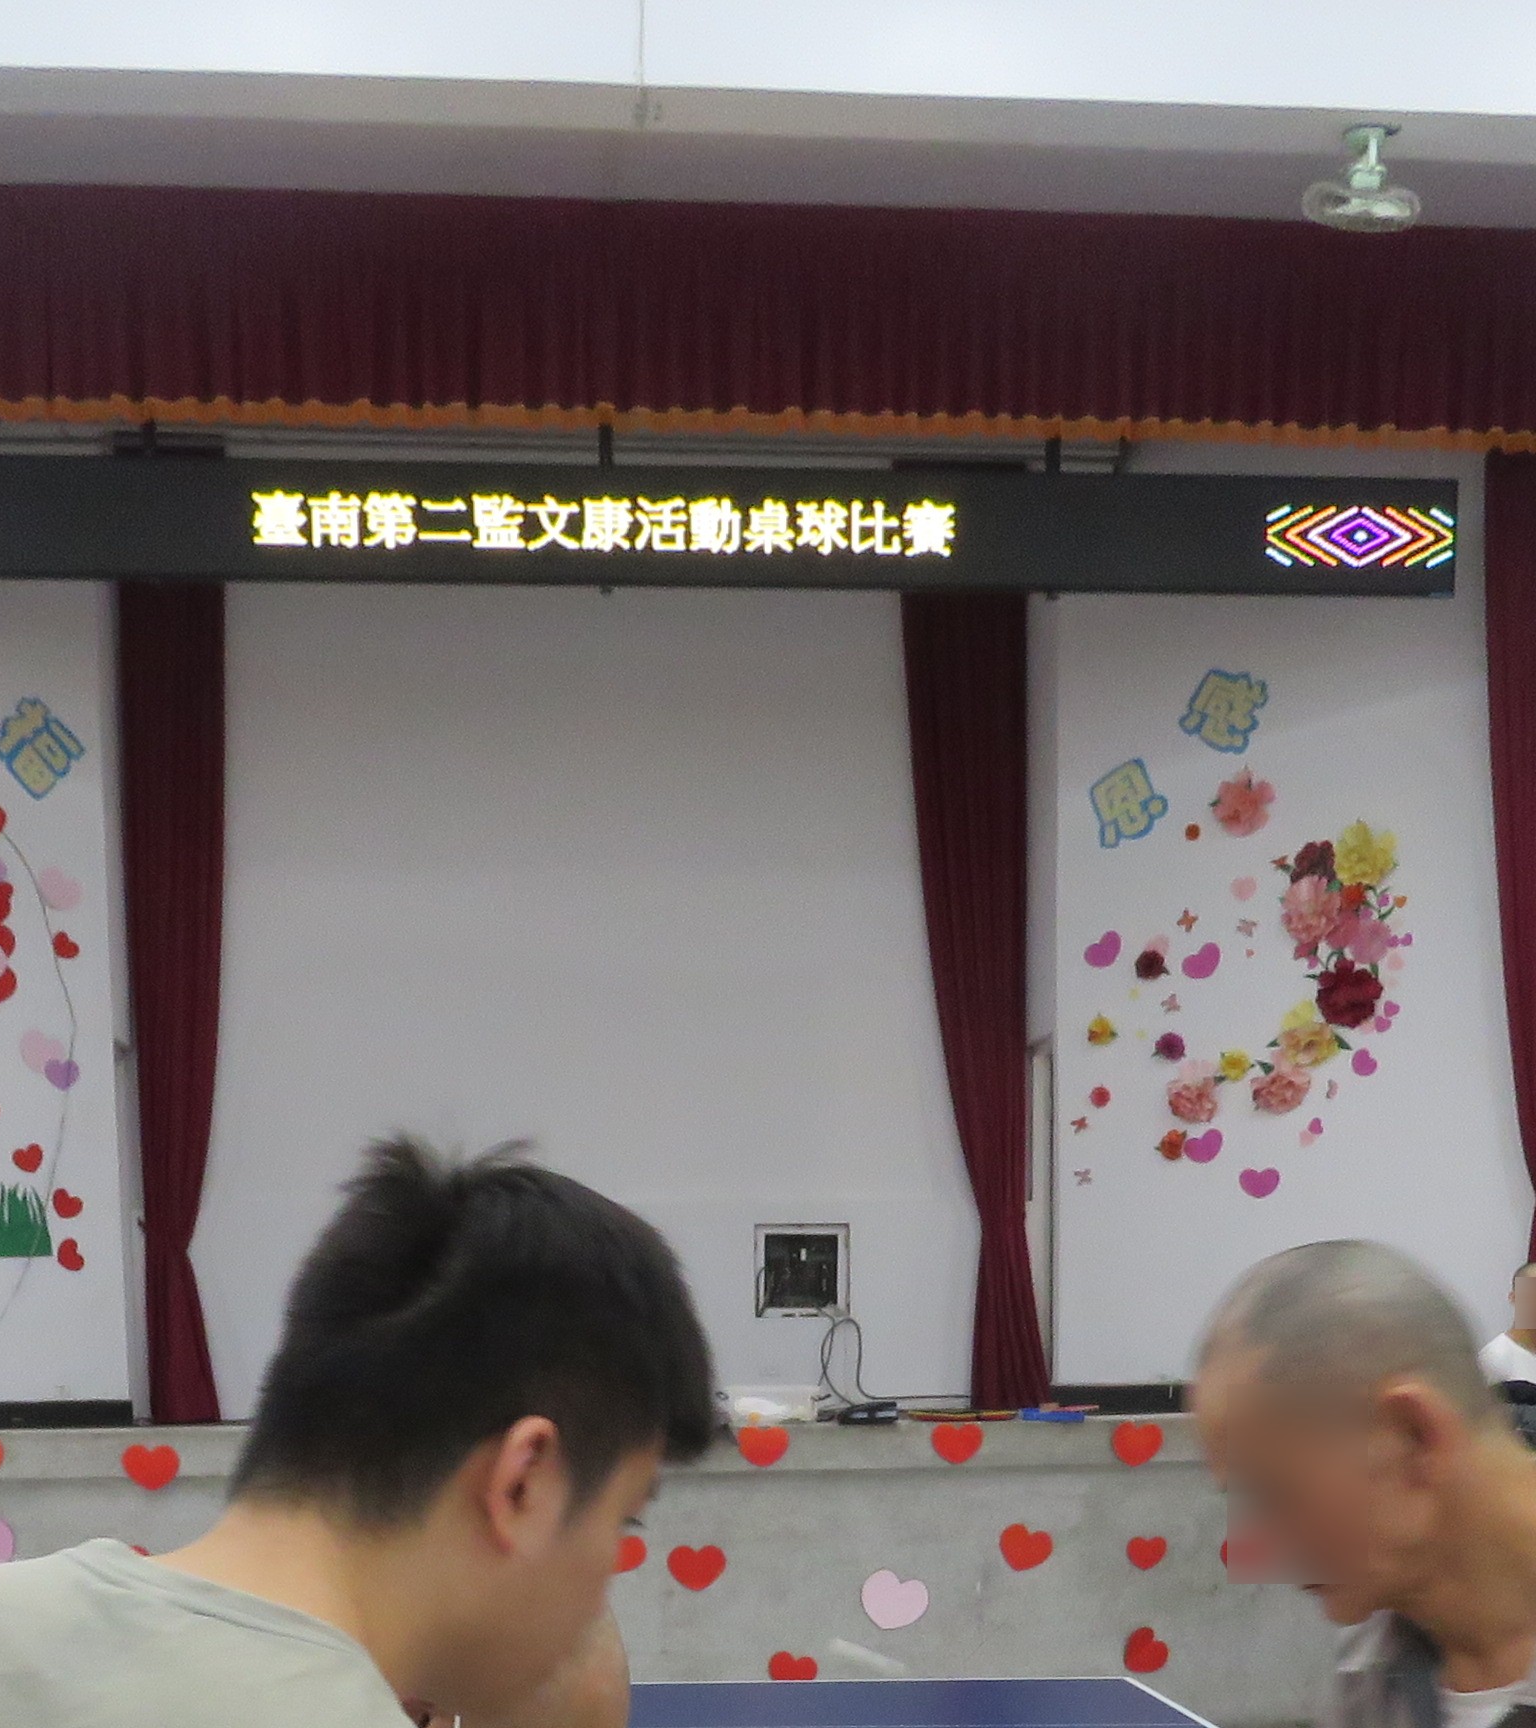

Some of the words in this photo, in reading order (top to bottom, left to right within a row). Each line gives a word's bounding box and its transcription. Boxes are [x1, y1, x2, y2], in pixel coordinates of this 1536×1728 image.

[252, 490, 955, 557] 臺南第二監文康活動桌球比賽
